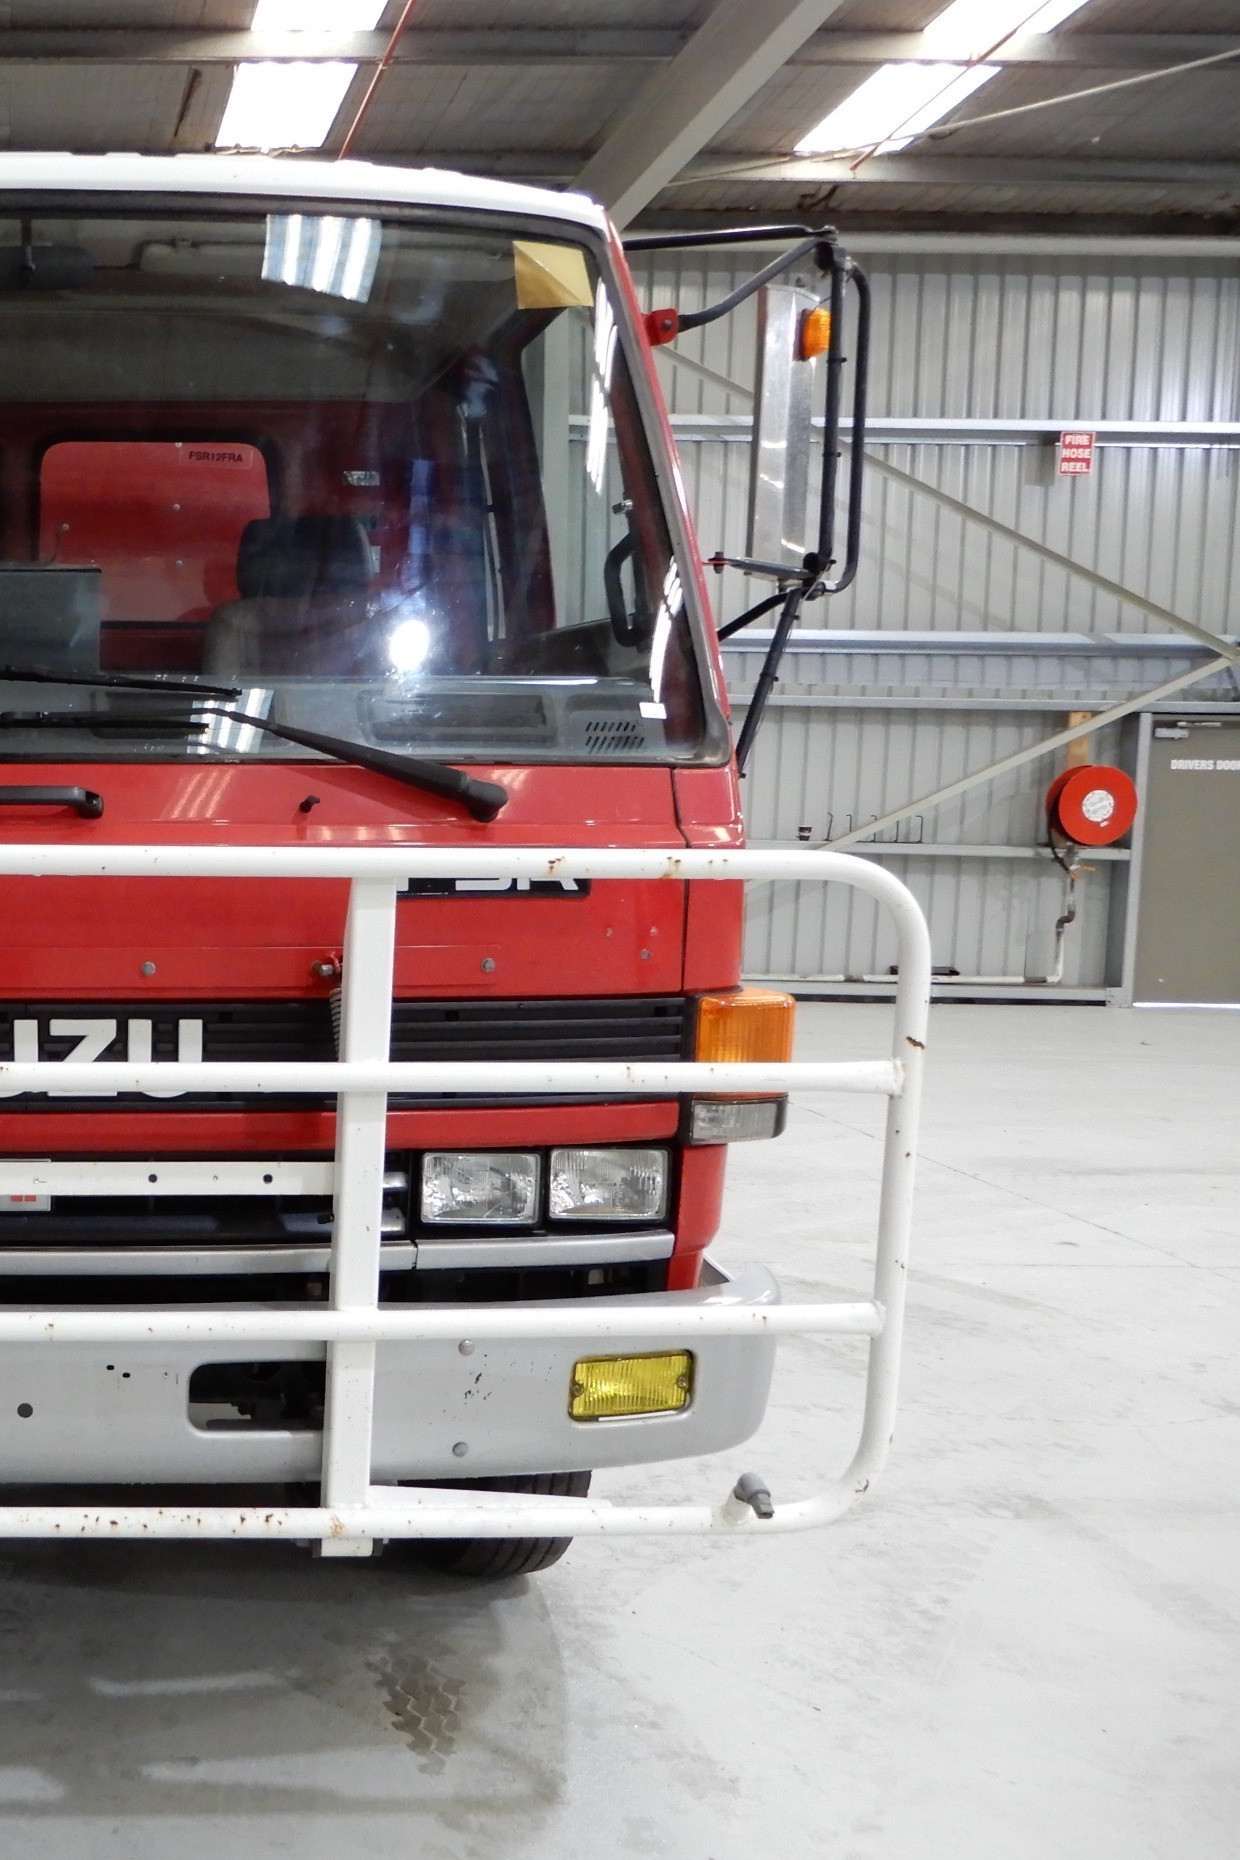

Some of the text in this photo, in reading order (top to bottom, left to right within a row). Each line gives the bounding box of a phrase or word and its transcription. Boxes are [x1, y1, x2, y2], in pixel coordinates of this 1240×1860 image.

[1064, 435, 1090, 446] FIRE
[188, 451, 243, 462] FSR12FRA
[1062, 448, 1091, 459] HOSE
[1061, 462, 1088, 472] REEL
[1170, 759, 1214, 770] DRIVERS
